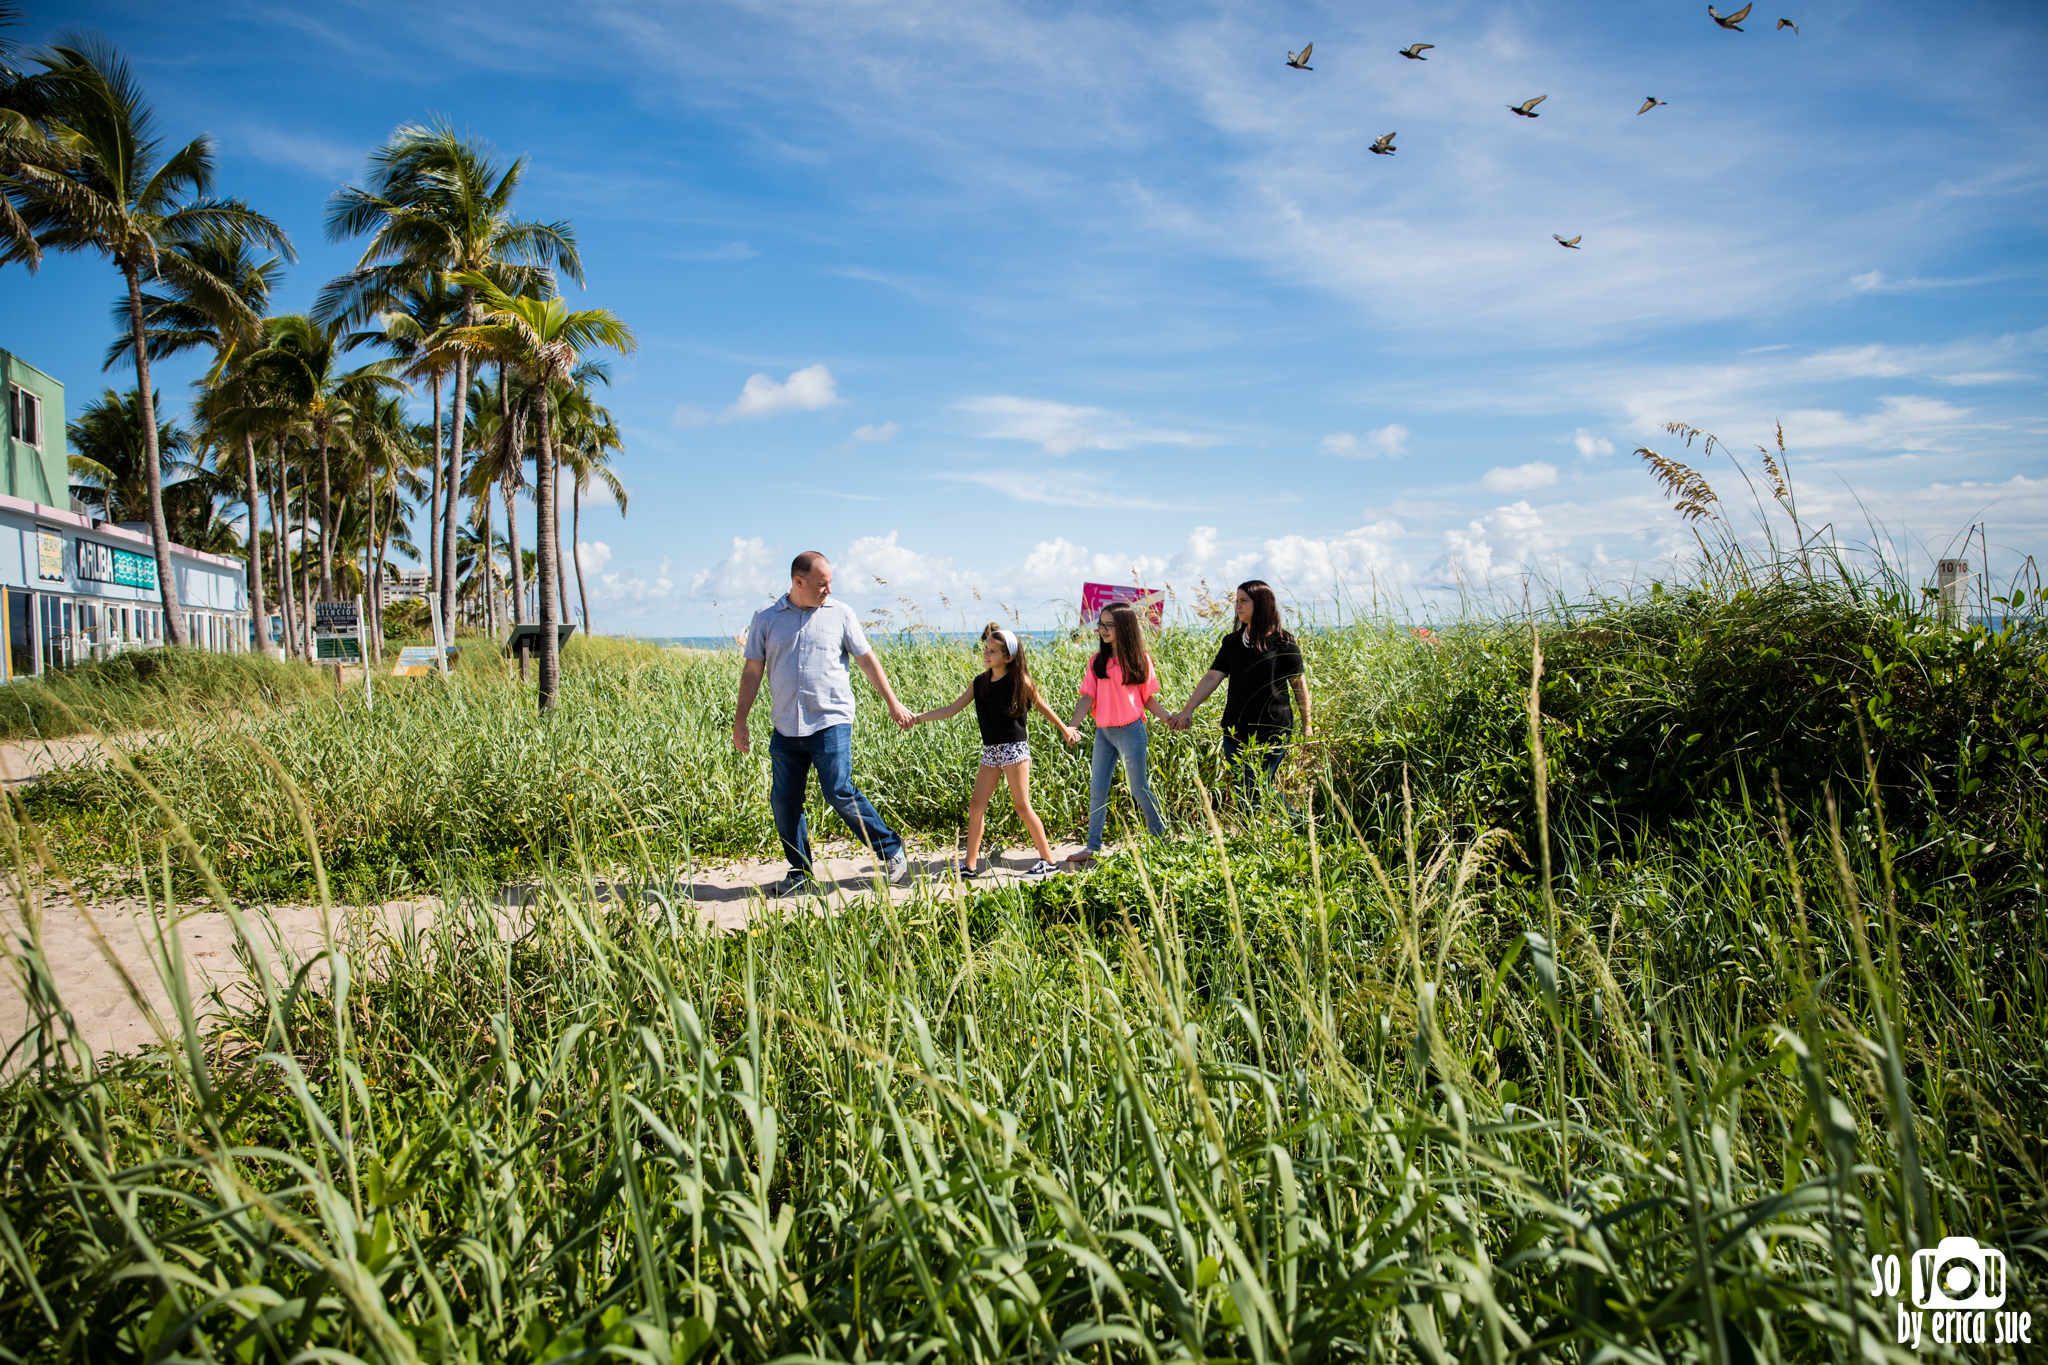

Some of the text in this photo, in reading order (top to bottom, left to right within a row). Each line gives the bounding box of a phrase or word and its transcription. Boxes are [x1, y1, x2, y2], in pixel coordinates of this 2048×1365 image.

[40, 554, 62, 571] ENTRANCE
[80, 541, 114, 583] ARUBA
[118, 559, 136, 576] BEACH
[1941, 563, 1953, 572] 10
[1958, 563, 1967, 572] 10
